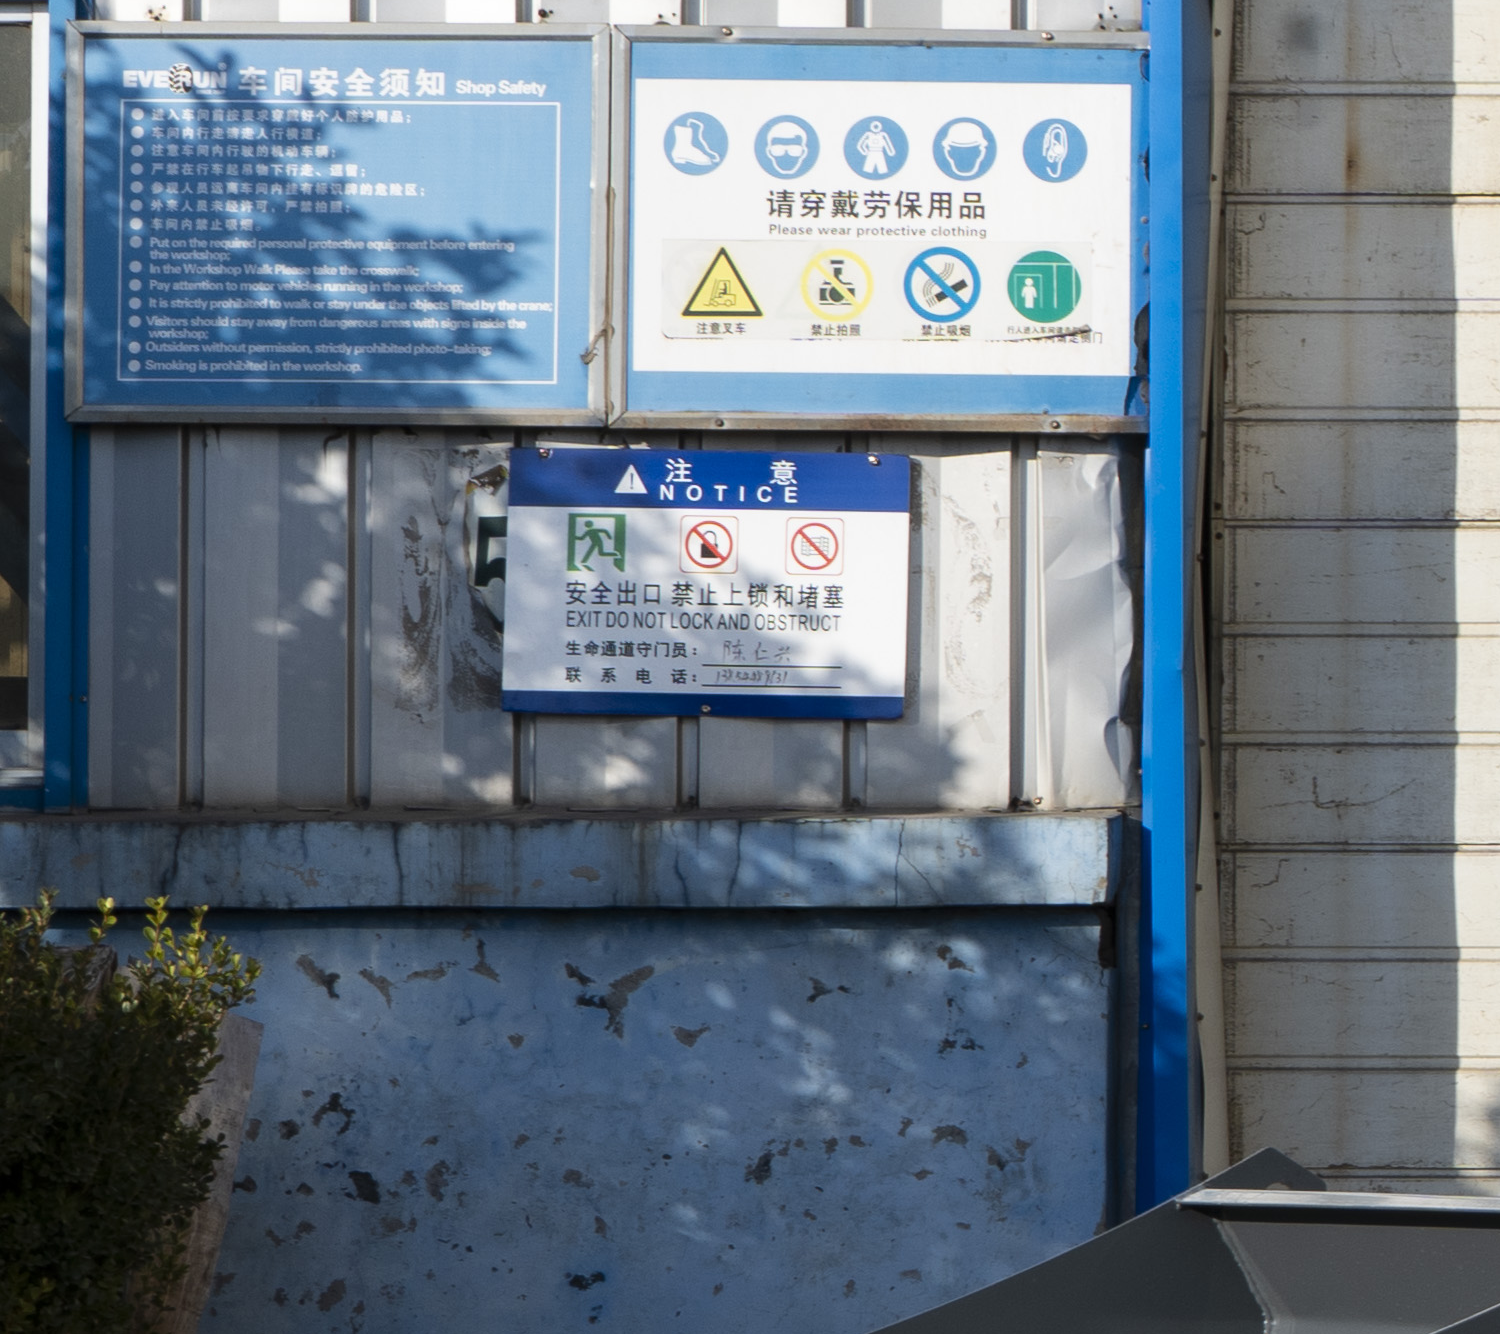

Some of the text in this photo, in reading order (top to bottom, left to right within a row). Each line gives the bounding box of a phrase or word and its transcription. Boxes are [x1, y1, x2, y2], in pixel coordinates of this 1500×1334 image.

[122, 65, 228, 92] EVERUN
[238, 66, 446, 97] 车间安全须知
[456, 79, 546, 98] Shop Safety
[766, 189, 987, 220] 请穿戴劳保用品
[768, 224, 988, 239] Please wear protective clothing
[150, 238, 515, 253] Put on the required personal protective equipment before entering
[150, 250, 230, 262] the workshop;
[150, 264, 160, 274] In
[163, 264, 181, 275] the
[183, 264, 241, 276] Workshop
[244, 264, 273, 275] Walk
[275, 265, 311, 275] Please
[313, 265, 337, 275] take
[339, 266, 358, 276] the
[149, 280, 463, 294] Pay attention to motor vehicles running in the workshop;
[149, 298, 158, 308] It
[159, 299, 168, 308] is
[171, 299, 208, 310] strictly
[210, 299, 268, 310] prohibited
[270, 300, 281, 309] to
[284, 299, 311, 309] walk
[314, 301, 325, 309] or
[328, 300, 351, 311] stay
[353, 300, 386, 309] under
[389, 300, 407, 310] the
[409, 300, 449, 312] objects
[451, 300, 479, 310] lifted
[481, 300, 495, 312] by
[498, 300, 517, 311] the
[146, 317, 526, 330] Visitors should stay away from dangerous areas with signs inside the
[697, 323, 746, 335] 注意叉车
[811, 324, 861, 336] 禁止拍照
[921, 324, 971, 336] 禁止吸烟
[145, 342, 200, 353] Outsiders
[202, 342, 246, 353] without
[315, 343, 352, 355] strictly
[354, 344, 411, 355] prohibited
[145, 360, 196, 372] Smoking
[199, 360, 208, 371] is
[210, 360, 268, 372] prohibited
[270, 361, 279, 371] in
[282, 361, 301, 371] the
[665, 458, 798, 485] 注意
[659, 484, 799, 504] NOTICE
[565, 581, 844, 611] 安全出口 禁止上锁和堵塞
[566, 611, 841, 632] EXIT DO NOT LOCK AND OBSTRUCT
[565, 640, 698, 658] 生命通道守门员：
